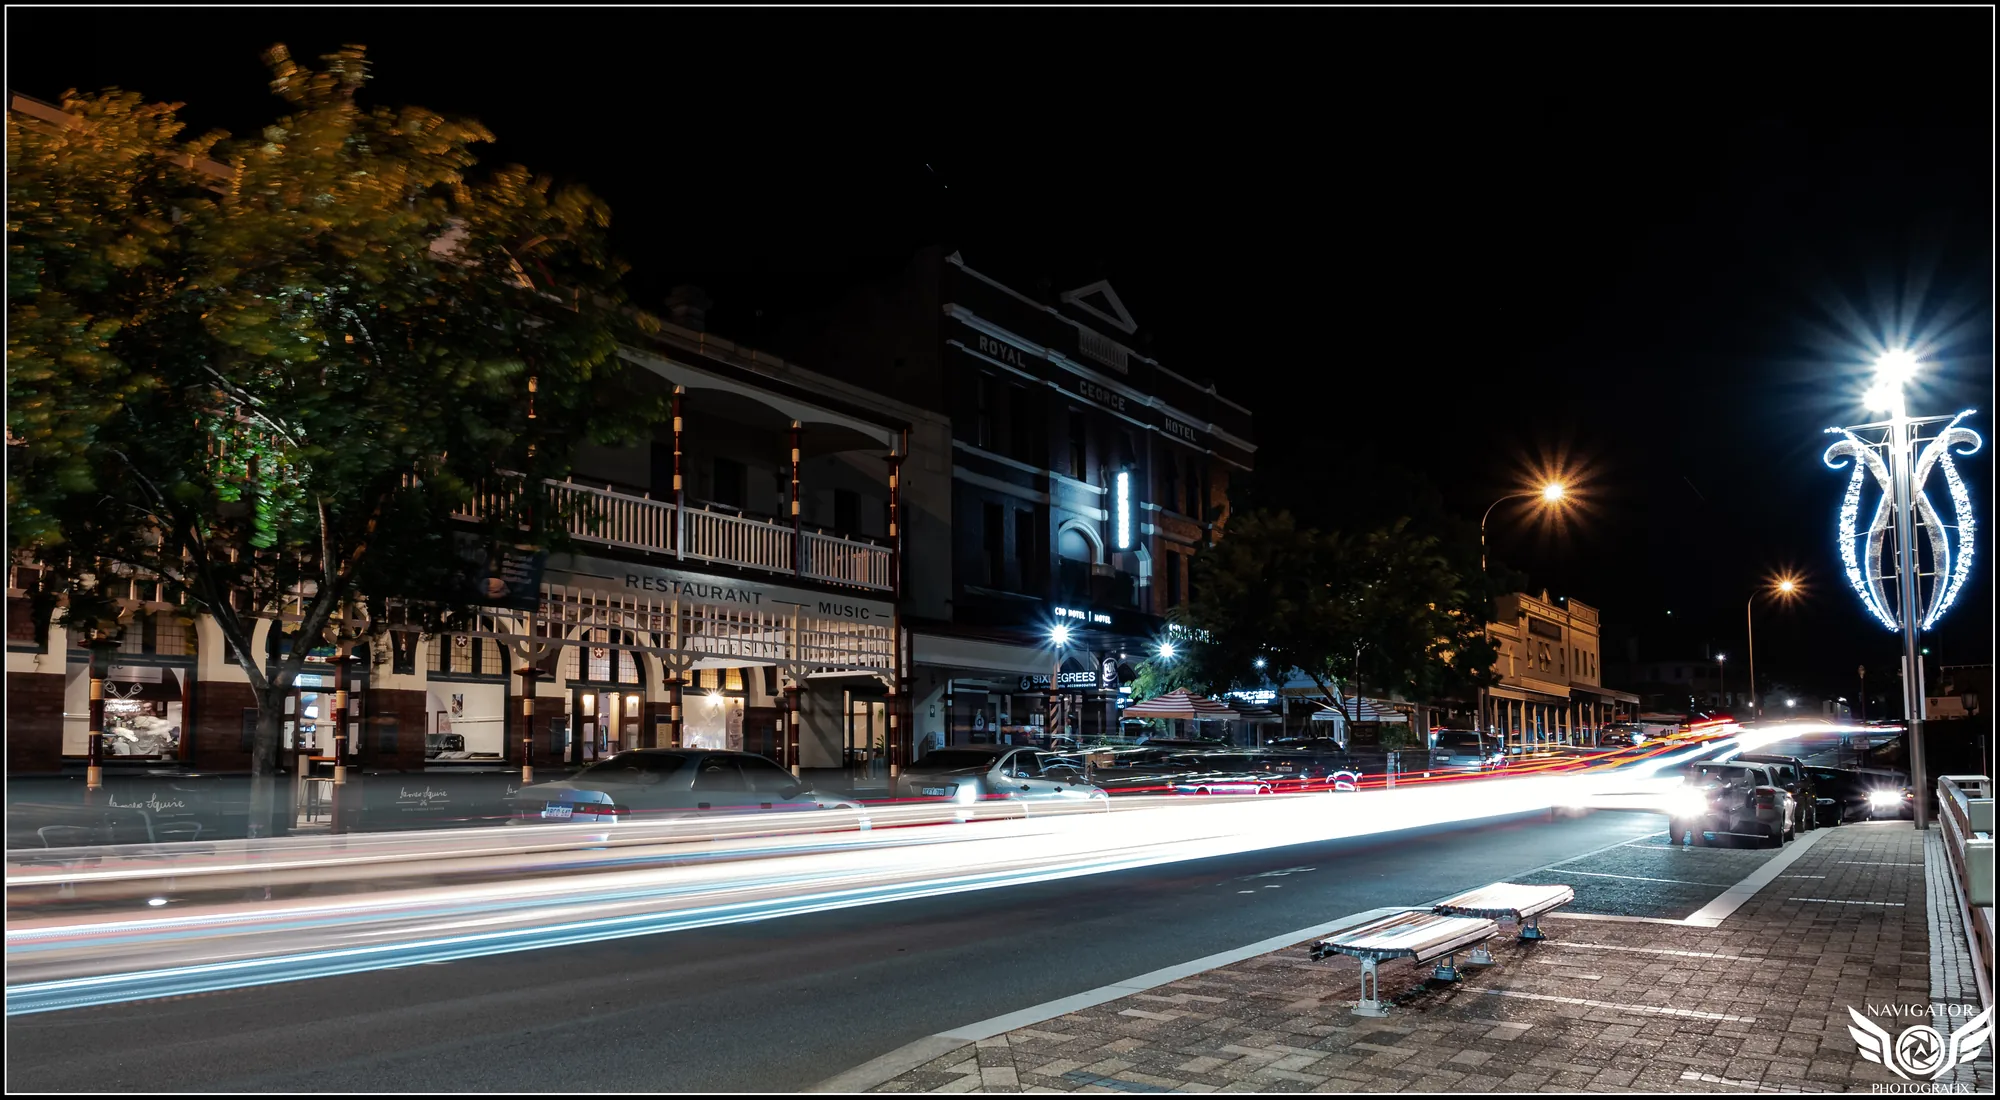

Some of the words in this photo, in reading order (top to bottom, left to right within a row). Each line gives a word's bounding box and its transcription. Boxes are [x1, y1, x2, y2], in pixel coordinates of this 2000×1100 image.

[979, 335, 1026, 369] ROYAL
[1079, 380, 1126, 412] GEORGE
[1165, 417, 1197, 442] HOTEL
[625, 573, 763, 605] RESTAURANT
[818, 600, 871, 620] MUSIC
[694, 643, 738, 655] WHTE
[145, 792, 186, 812] Squire
